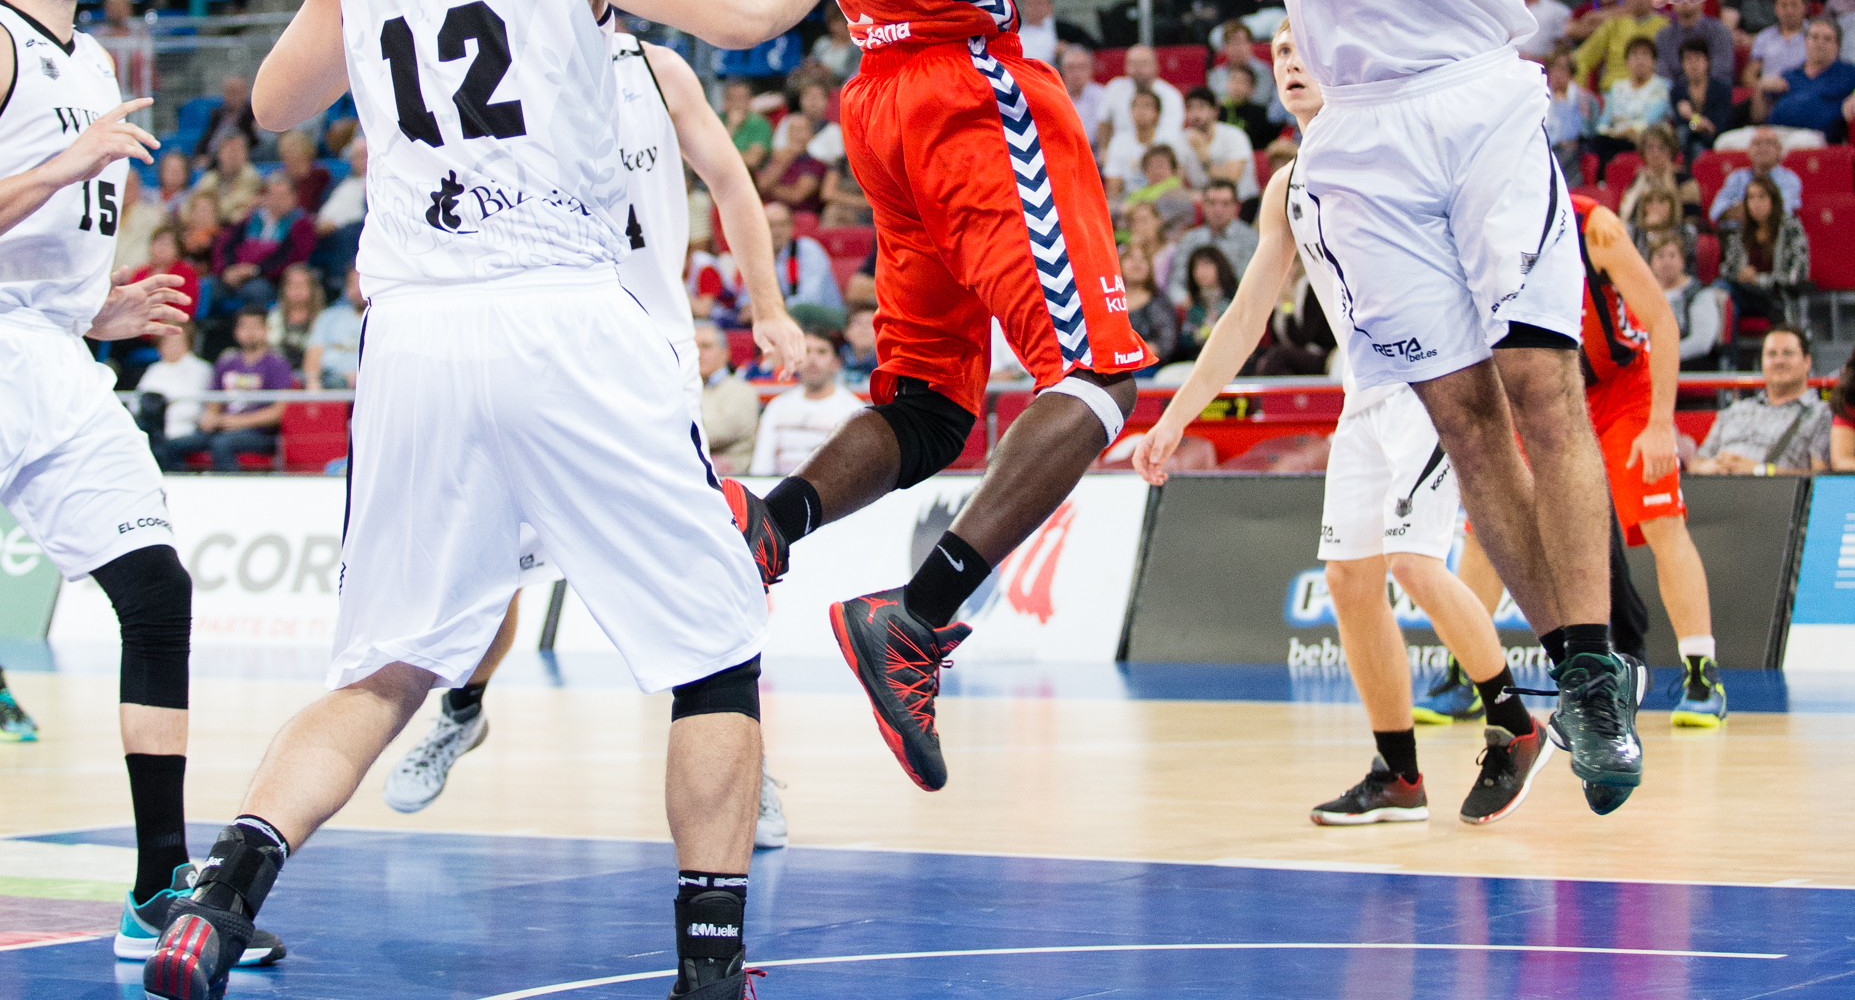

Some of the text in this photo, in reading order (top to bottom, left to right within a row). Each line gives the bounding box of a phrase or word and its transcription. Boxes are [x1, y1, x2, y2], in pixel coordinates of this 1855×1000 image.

[379, 0, 528, 149] 12
[619, 145, 658, 172] key
[78, 179, 118, 237] 15
[117, 522, 135, 535] EL
[187, 532, 342, 595] COR
